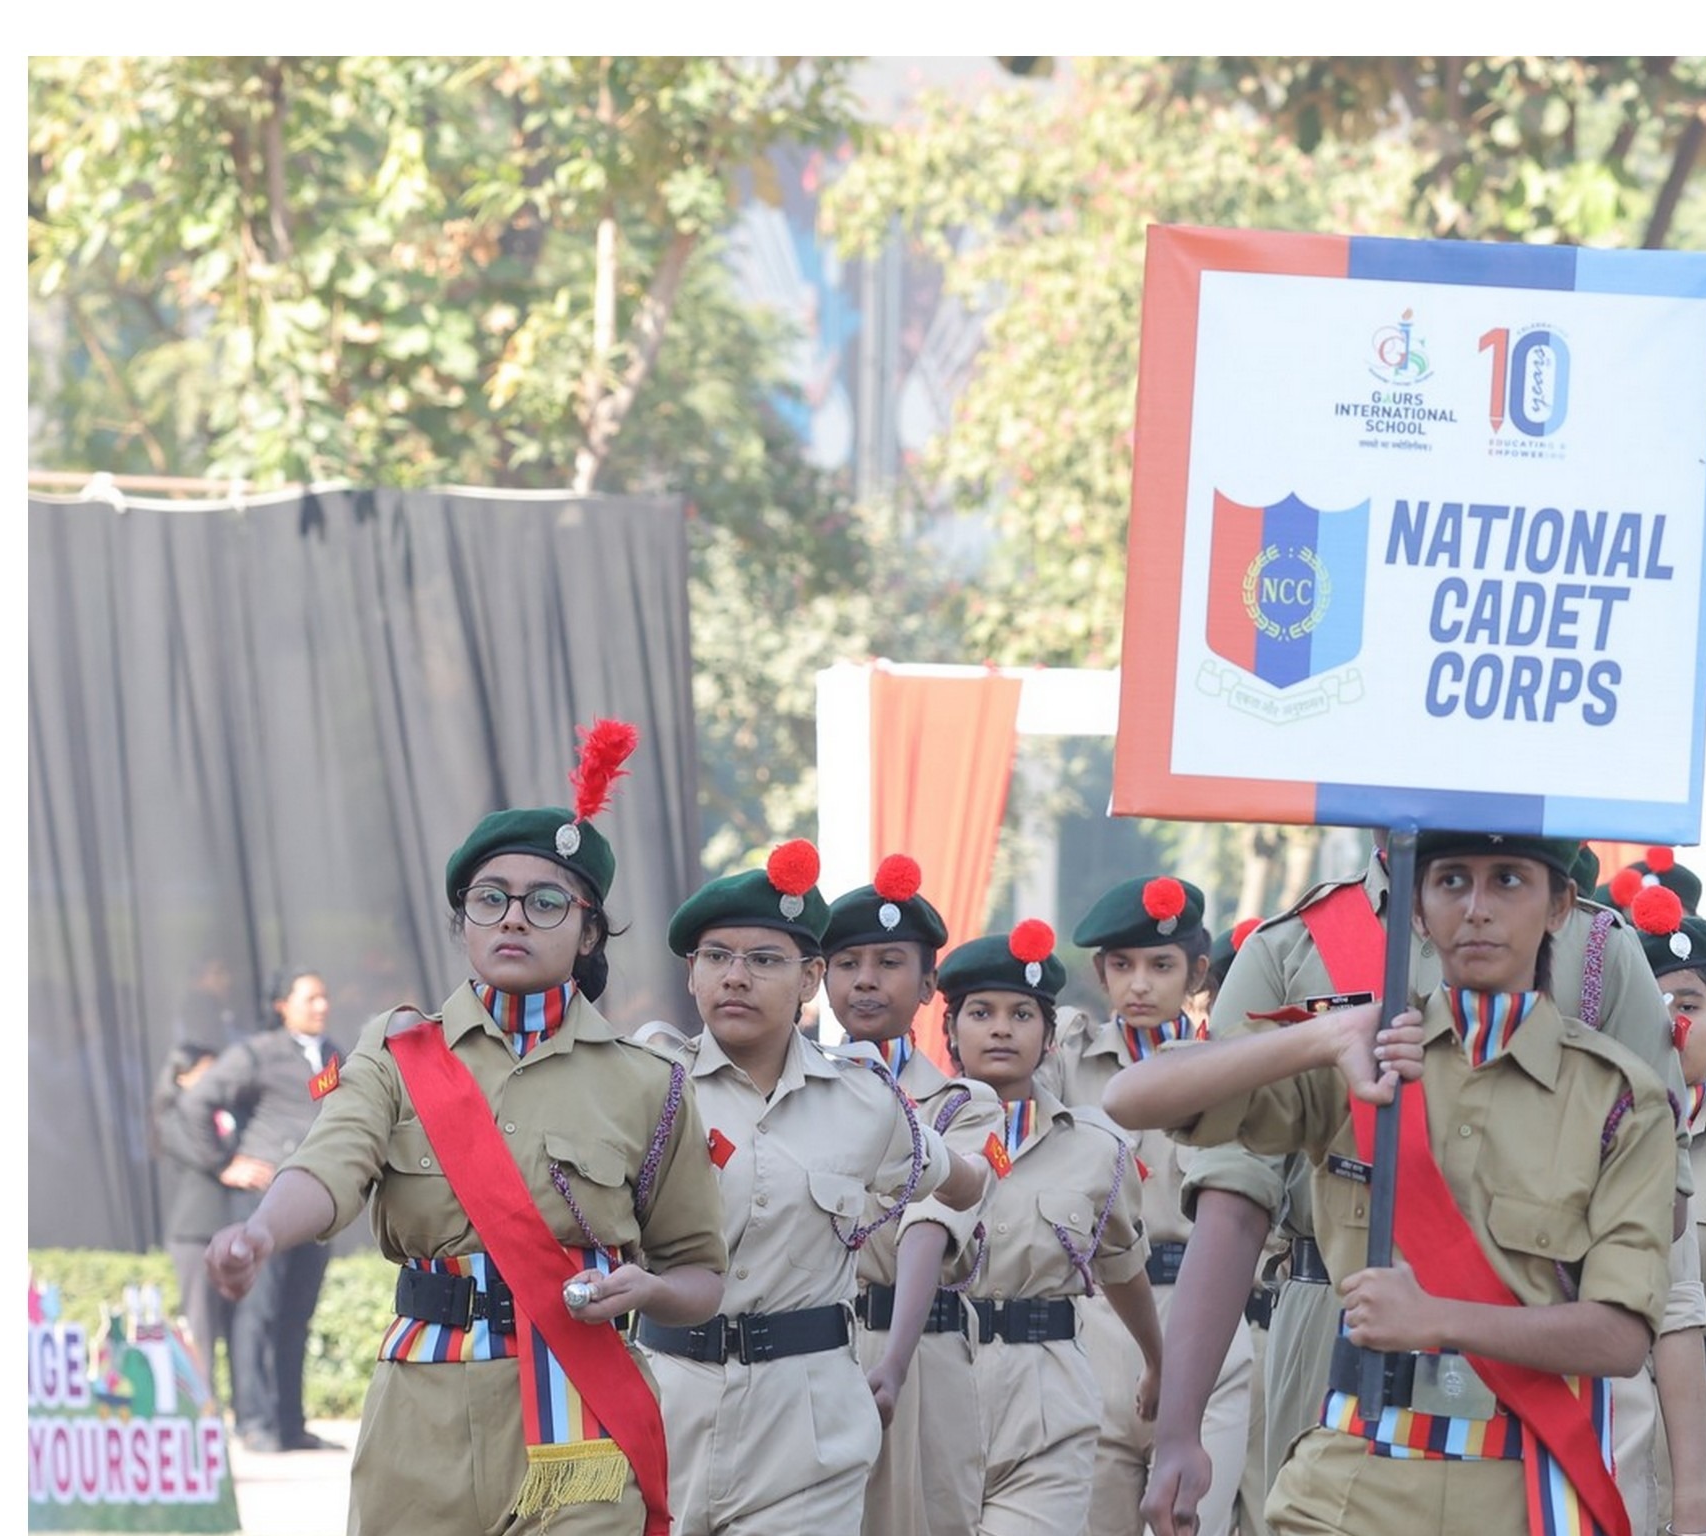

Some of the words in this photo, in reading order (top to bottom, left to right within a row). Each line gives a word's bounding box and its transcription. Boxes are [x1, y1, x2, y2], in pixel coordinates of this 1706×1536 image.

[1335, 403, 1458, 424] INTERNATIONAL
[1371, 390, 1424, 407] GAURS
[1477, 327, 1571, 437] 10
[1365, 419, 1427, 436] SCHOOL
[1385, 499, 1674, 581] NATIONAL
[1261, 577, 1313, 606] NCC
[1429, 576, 1631, 651] CADET
[1425, 651, 1622, 727] CORPS
[29, 1427, 219, 1493] YOURSELF
